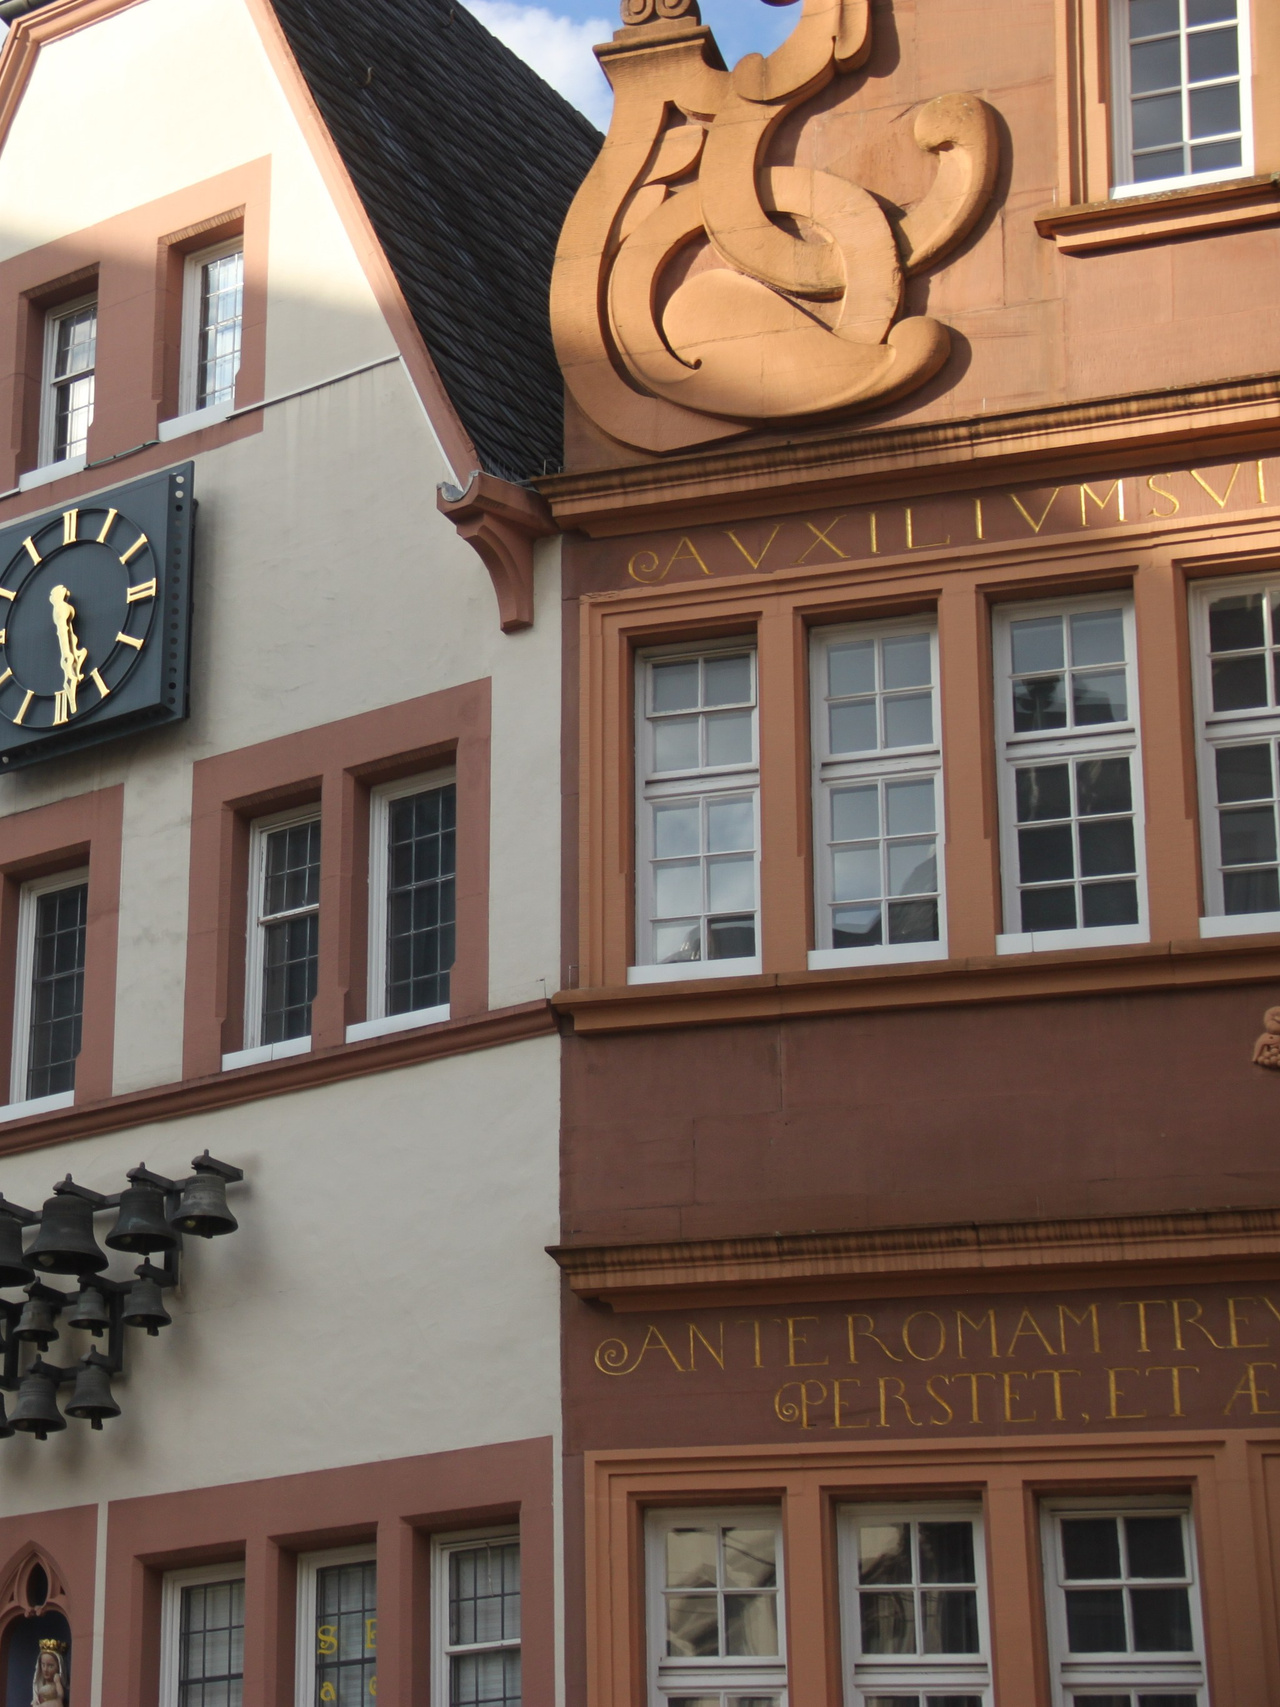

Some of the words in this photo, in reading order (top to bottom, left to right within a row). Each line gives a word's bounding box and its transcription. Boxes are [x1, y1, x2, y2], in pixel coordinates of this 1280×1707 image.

[595, 1316, 830, 1376] ANTE
[844, 1303, 1102, 1364] ROMAM
[1104, 1365, 1200, 1418] ET
